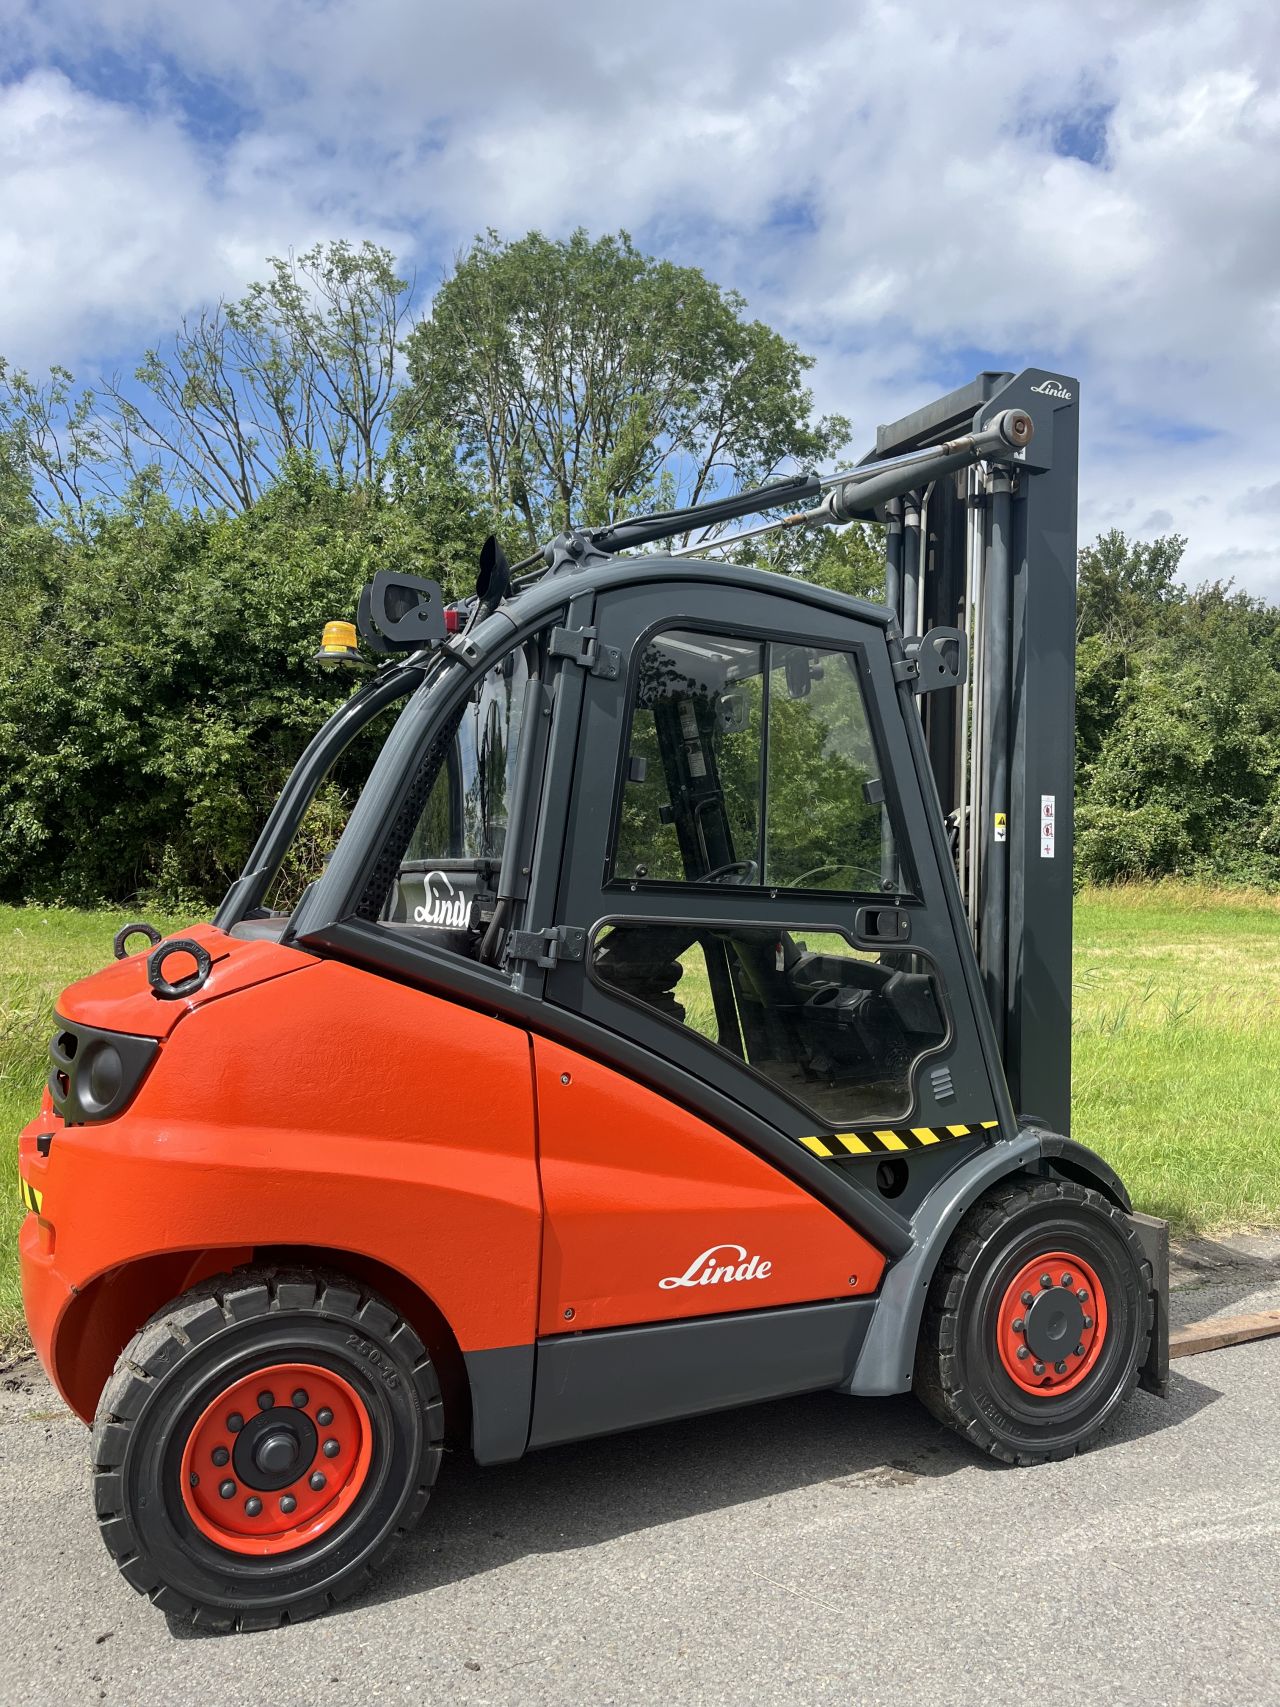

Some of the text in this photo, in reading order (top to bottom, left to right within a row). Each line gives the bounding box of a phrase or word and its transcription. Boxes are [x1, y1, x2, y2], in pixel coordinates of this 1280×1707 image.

[1030, 380, 1072, 400] Linde
[658, 1244, 772, 1290] Linde
[345, 1334, 399, 1388] 250-15
